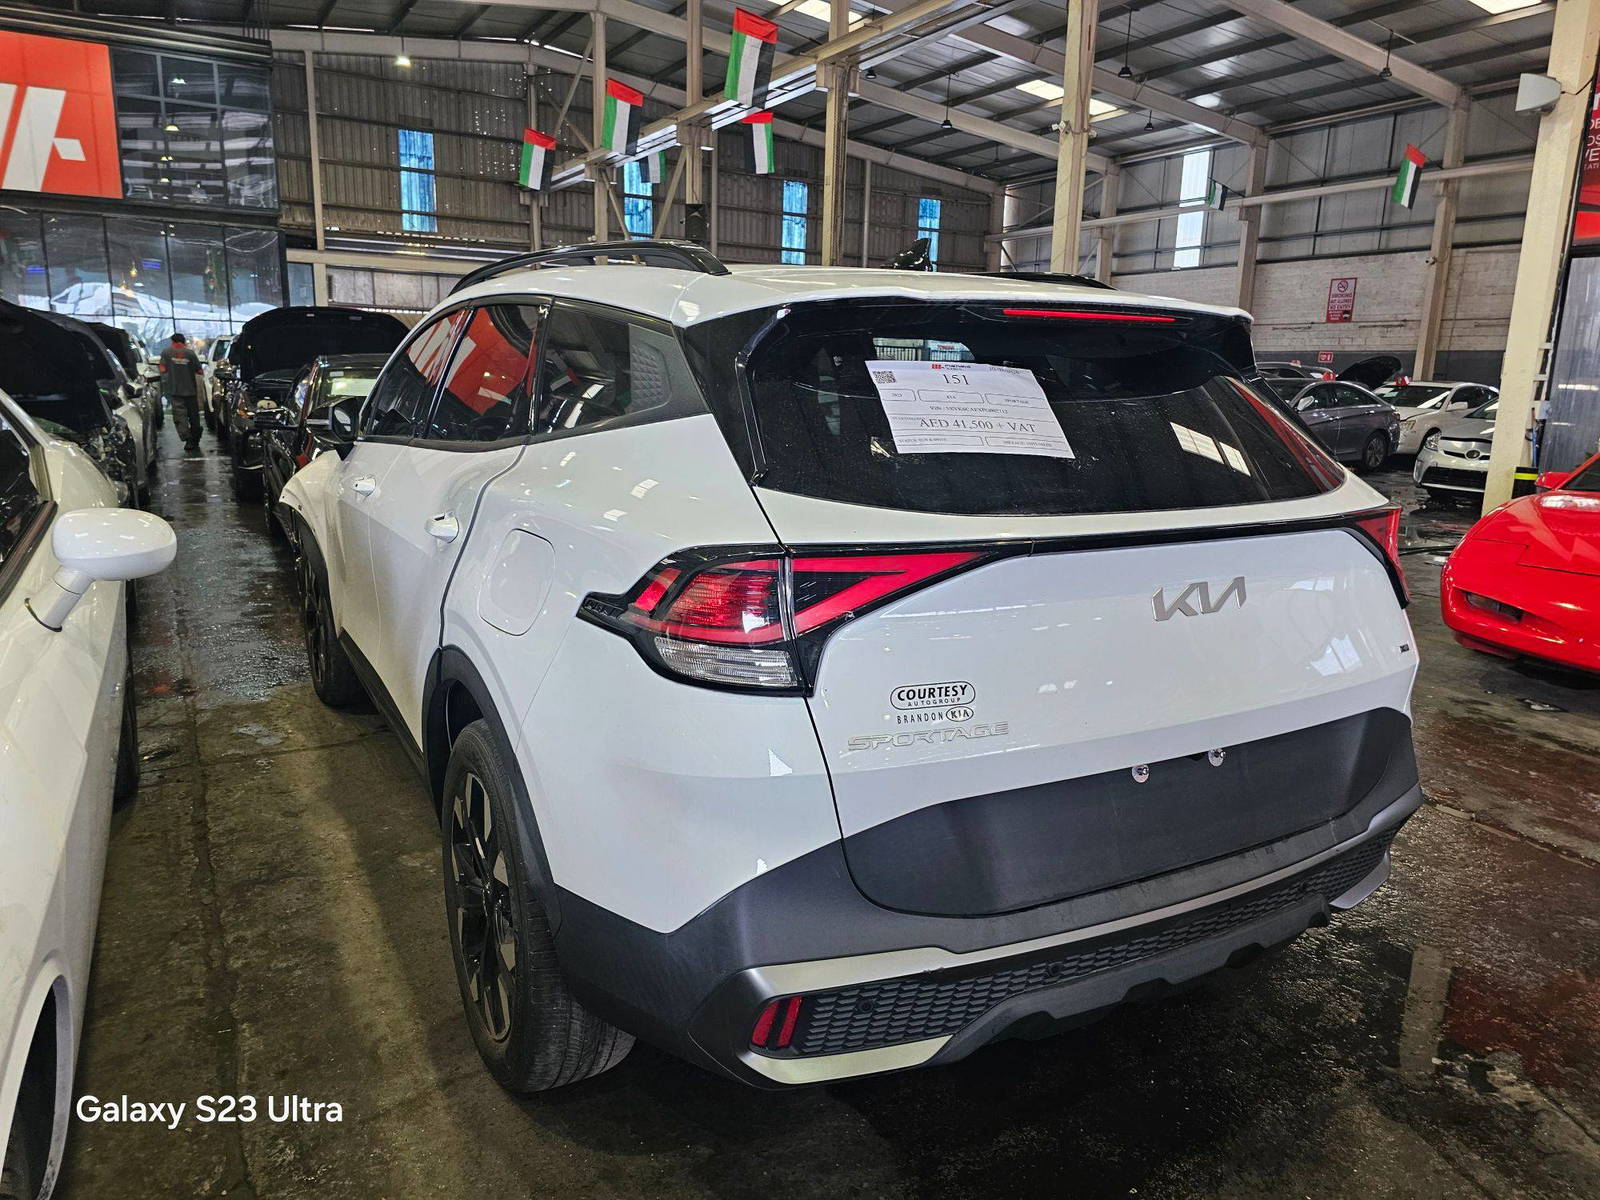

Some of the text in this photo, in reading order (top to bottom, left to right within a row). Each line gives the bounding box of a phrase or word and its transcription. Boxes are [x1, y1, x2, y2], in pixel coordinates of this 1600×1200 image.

[943, 374, 970, 386] 151
[920, 418, 949, 429] AED
[953, 419, 994, 430] 41,500
[1008, 421, 1036, 433] VAT
[897, 684, 968, 702] COURTESY
[907, 697, 961, 707] AUTOGROUP
[897, 709, 970, 725] BRANDON KIA
[847, 721, 1009, 751] SPORTAGE
